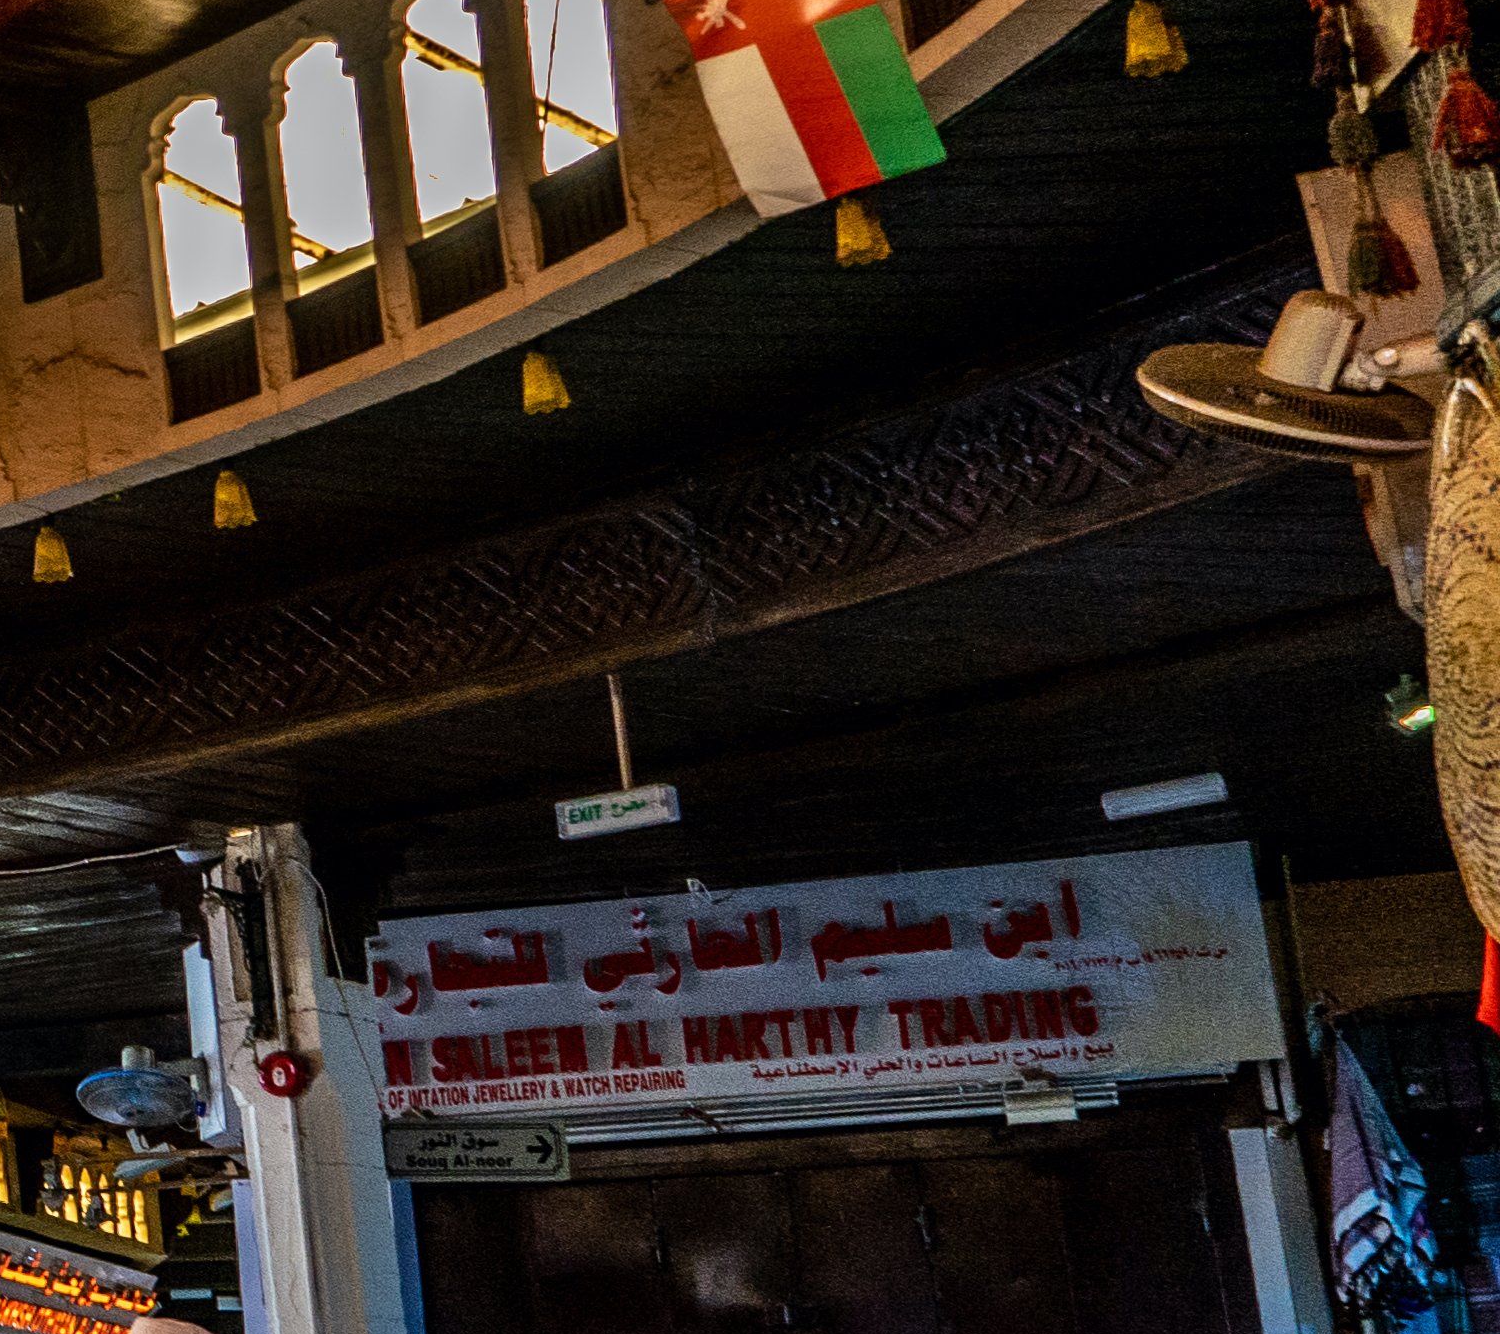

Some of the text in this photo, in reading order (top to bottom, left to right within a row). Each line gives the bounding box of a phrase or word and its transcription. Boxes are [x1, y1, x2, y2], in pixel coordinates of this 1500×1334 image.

[569, 804, 601, 824] EXIT
[583, 908, 782, 1012] الحارثي
[811, 900, 952, 984] سليم
[431, 1025, 589, 1083] SALEEM
[612, 1020, 662, 1070] AL
[682, 1004, 860, 1064] HARTHY
[888, 985, 1100, 1051] TRADING
[388, 1088, 405, 1110] OF
[473, 1080, 546, 1104] JEWELLERY
[551, 1079, 561, 1098] &
[564, 1074, 611, 1097] WATCH
[614, 1069, 685, 1093] REPAIRING
[462, 1132, 499, 1150] سوق
[405, 1154, 447, 1170] Souq
